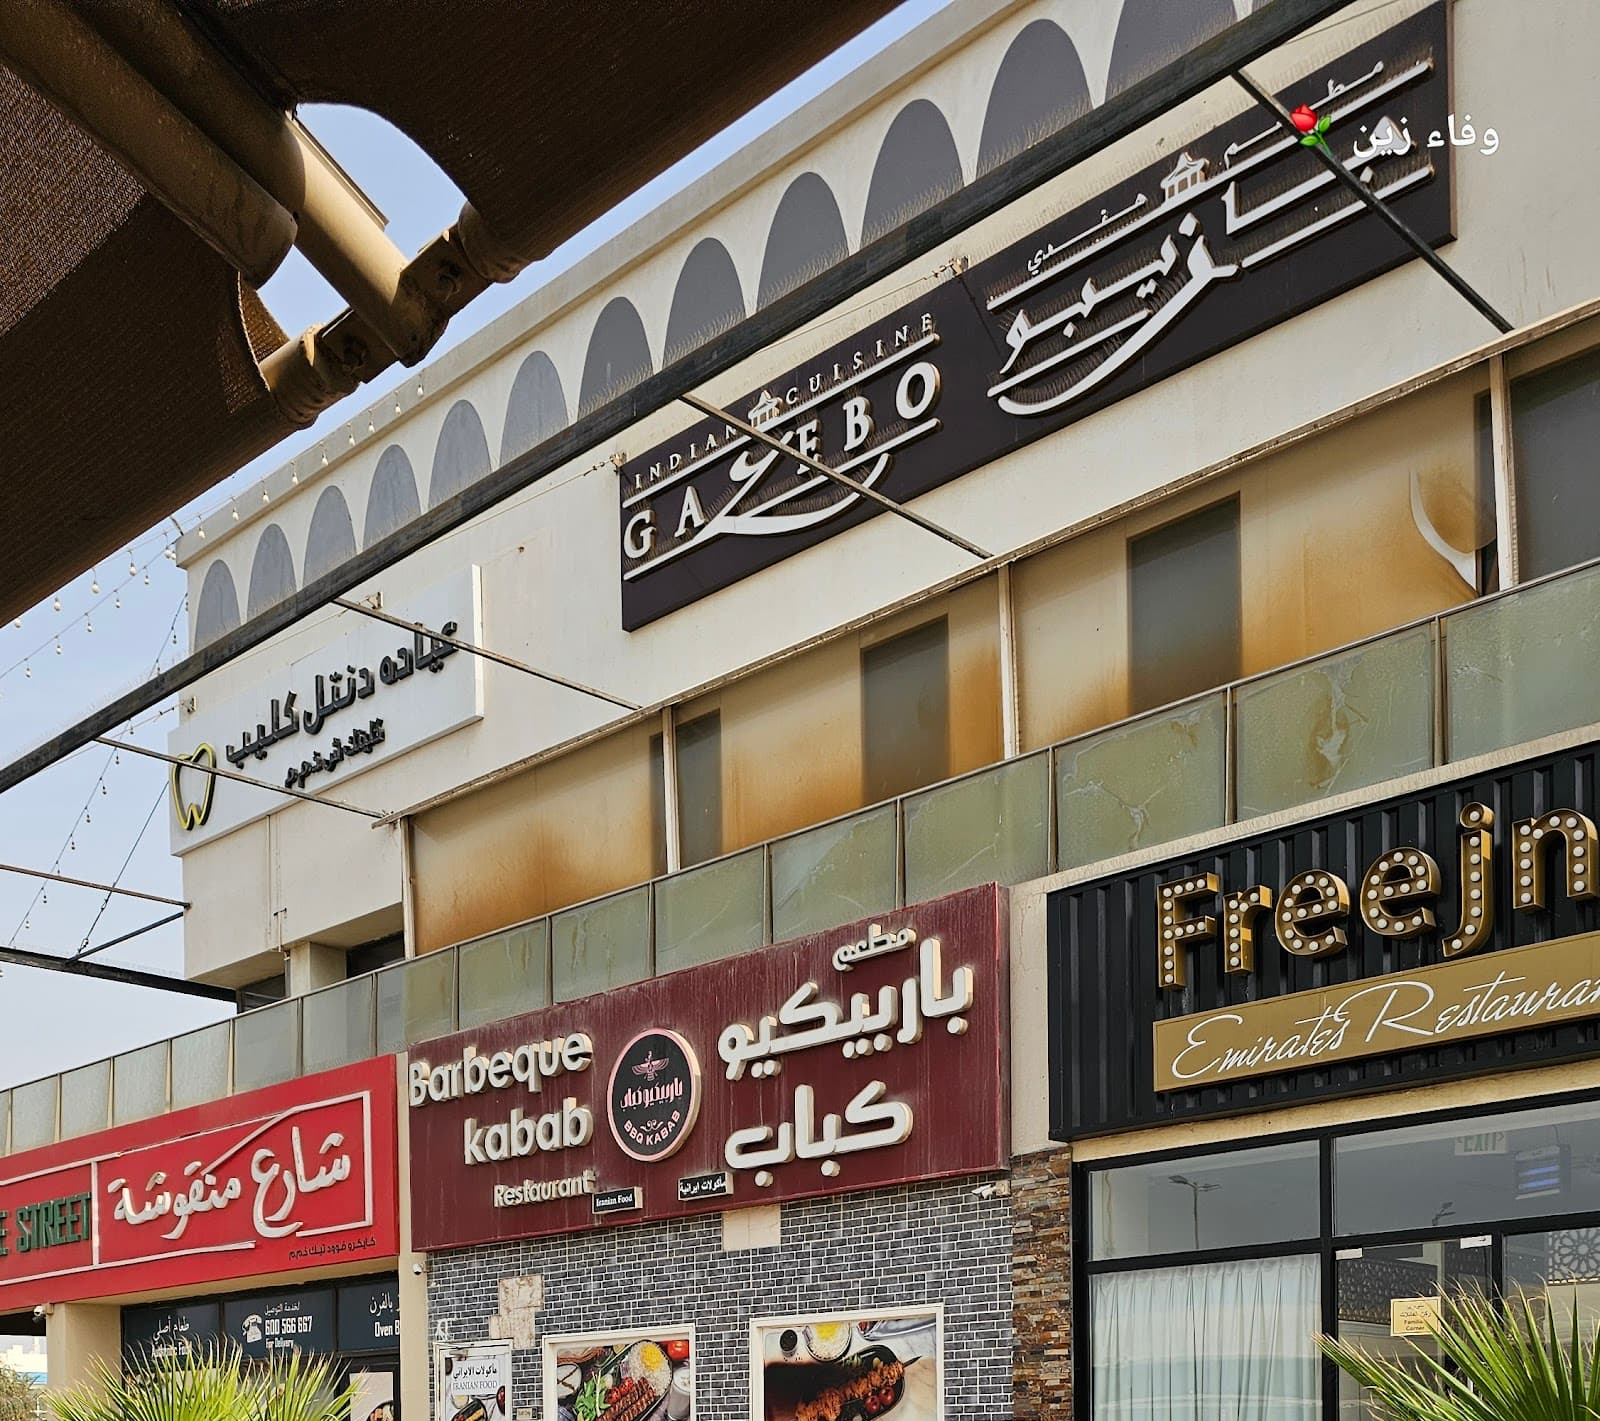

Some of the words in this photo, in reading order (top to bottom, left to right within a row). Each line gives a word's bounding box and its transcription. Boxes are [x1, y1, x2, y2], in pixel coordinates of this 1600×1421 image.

[1223, 60, 1384, 169] مطم
[634, 424, 737, 490] INDIAN
[785, 312, 935, 405] CUISINE
[623, 360, 942, 560] GAZEBO
[831, 922, 918, 973] مطعم
[717, 937, 976, 1080] باربيكيو
[1170, 1004, 1351, 1079] Emirates
[407, 1032, 594, 1107] Barbeque
[463, 1096, 594, 1166] kabab
[623, 1119, 644, 1145] BBQ
[646, 1110, 681, 1146] KABAB
[724, 1079, 914, 1187] كباب
[107, 1160, 242, 1240] منقوشة
[251, 1126, 351, 1239] شارع
[493, 1168, 598, 1208] Restaurant
[618, 1193, 633, 1204] Food
[16, 1191, 92, 1252] STREET
[265, 1318, 280, 1336] 600
[281, 1317, 297, 1334] 566
[374, 1321, 393, 1337] Oven
[479, 1380, 498, 1390] FOOD
